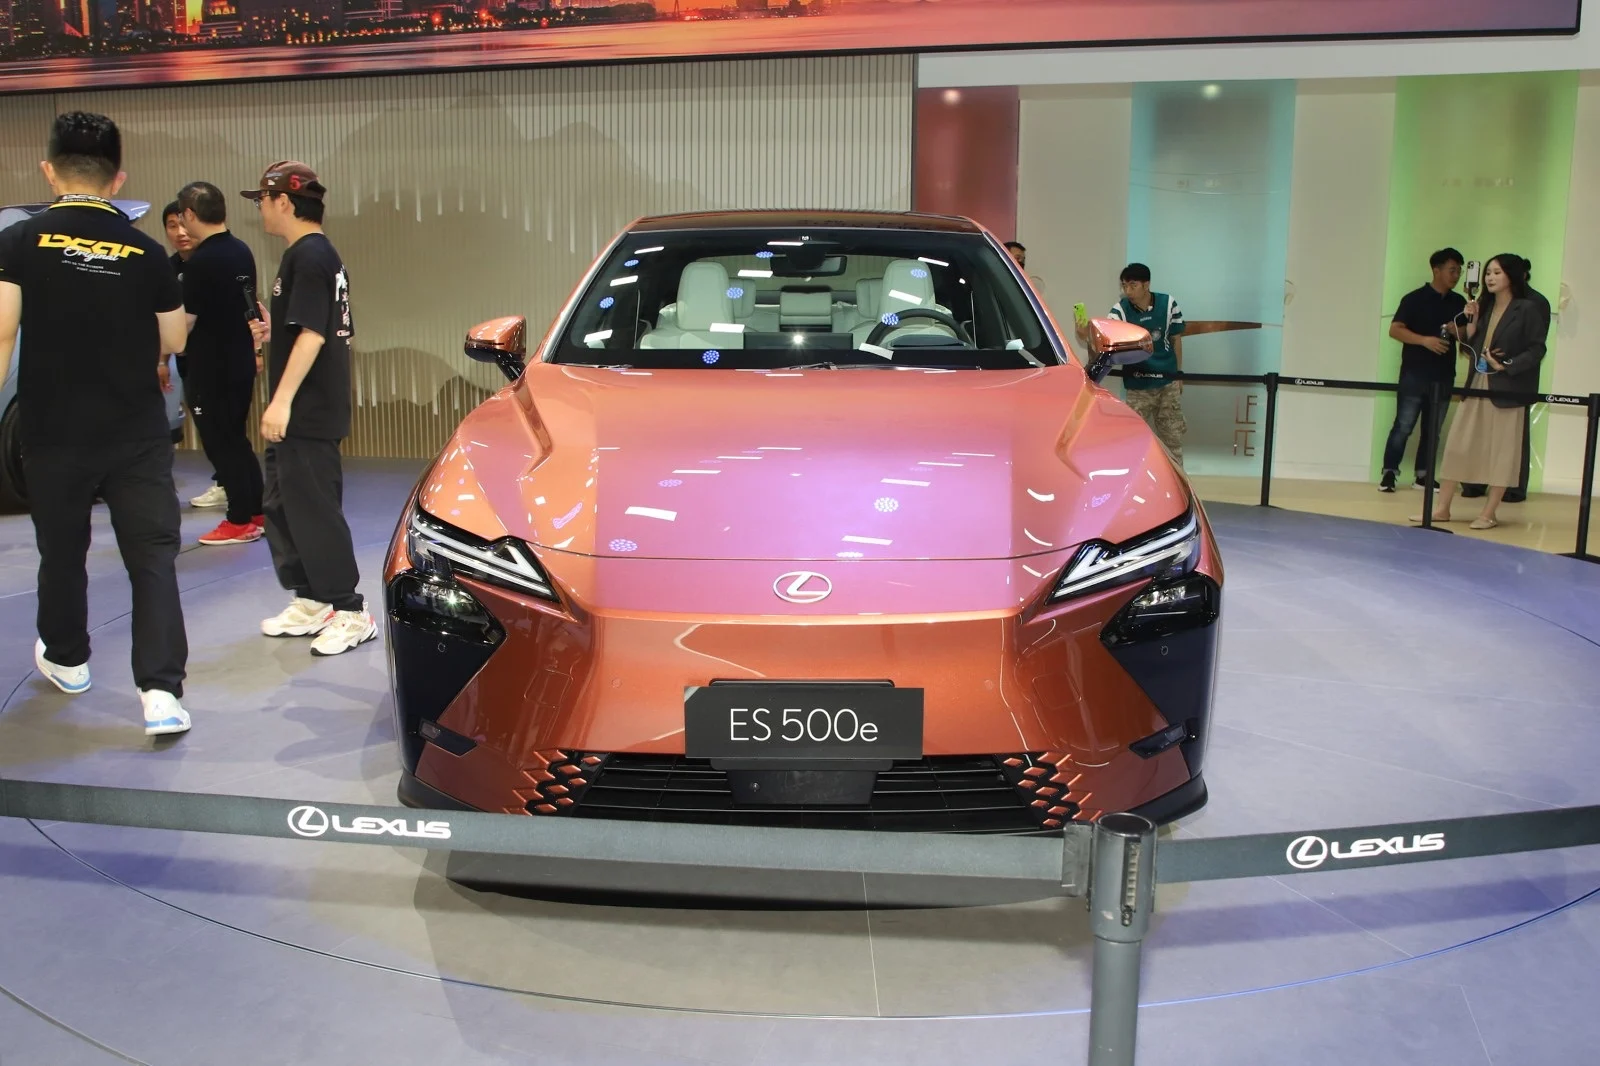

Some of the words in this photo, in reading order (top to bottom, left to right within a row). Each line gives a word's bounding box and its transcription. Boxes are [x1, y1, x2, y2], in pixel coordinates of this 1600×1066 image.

[63, 246, 120, 263] Original
[730, 708, 772, 742] ES
[781, 708, 879, 742] 500e
[331, 815, 452, 840] LEXUS
[1330, 832, 1445, 859] LEXUS
